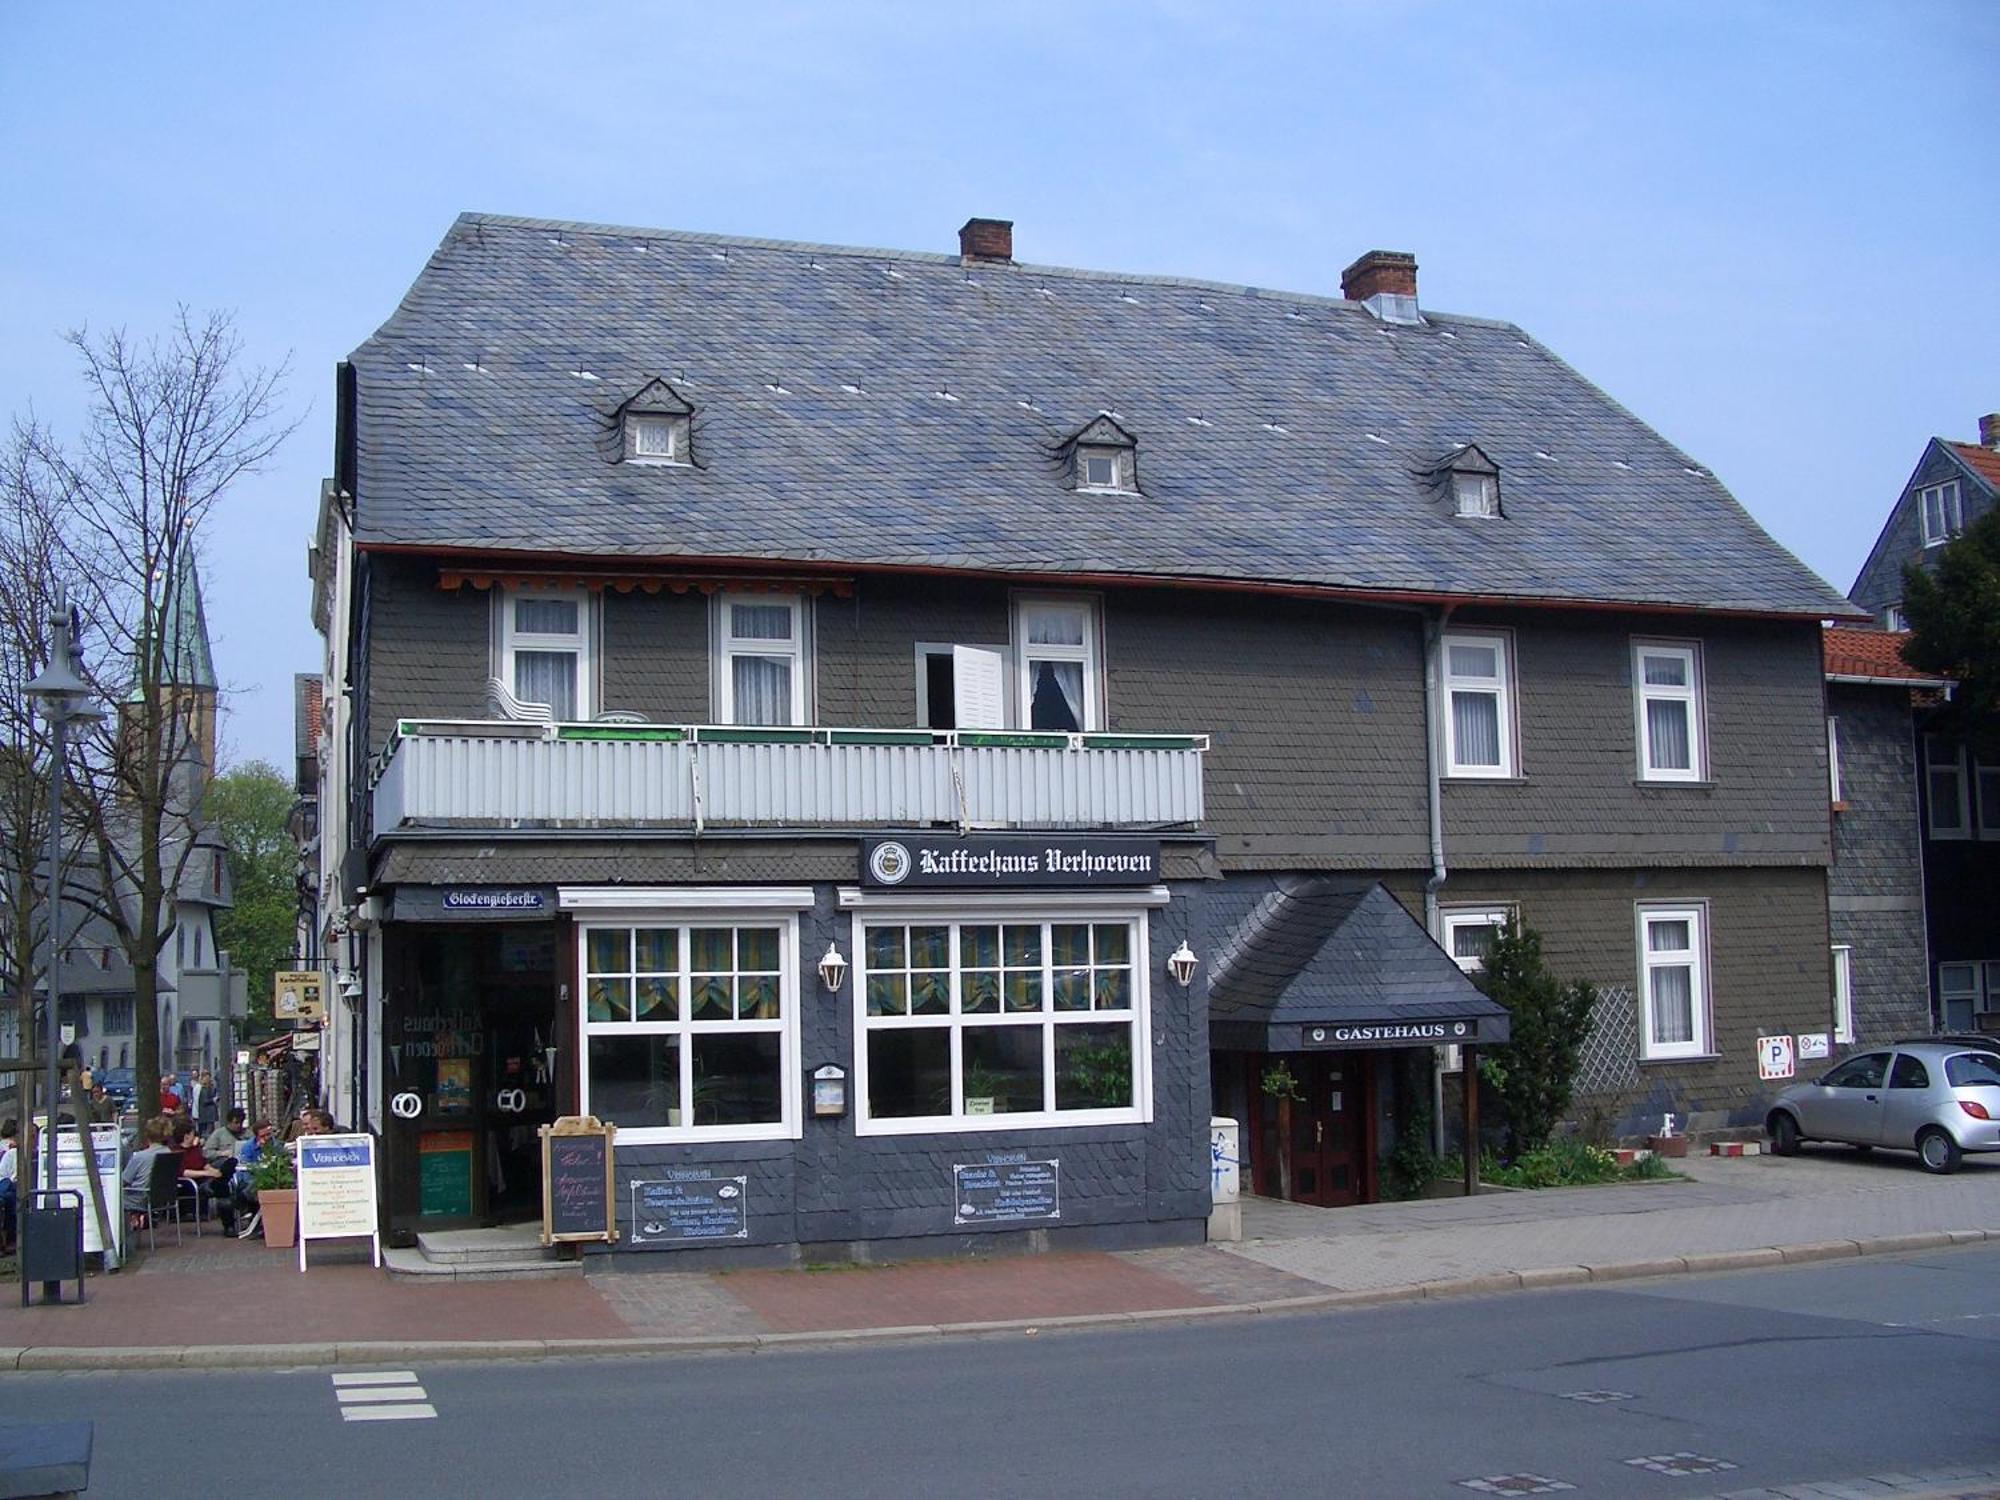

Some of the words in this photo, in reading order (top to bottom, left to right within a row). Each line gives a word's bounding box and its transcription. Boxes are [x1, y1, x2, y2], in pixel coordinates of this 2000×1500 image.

[920, 849, 1039, 877] Kaffeehaus
[1045, 849, 1152, 877] Verhoeven
[1771, 1046, 1782, 1062] P
